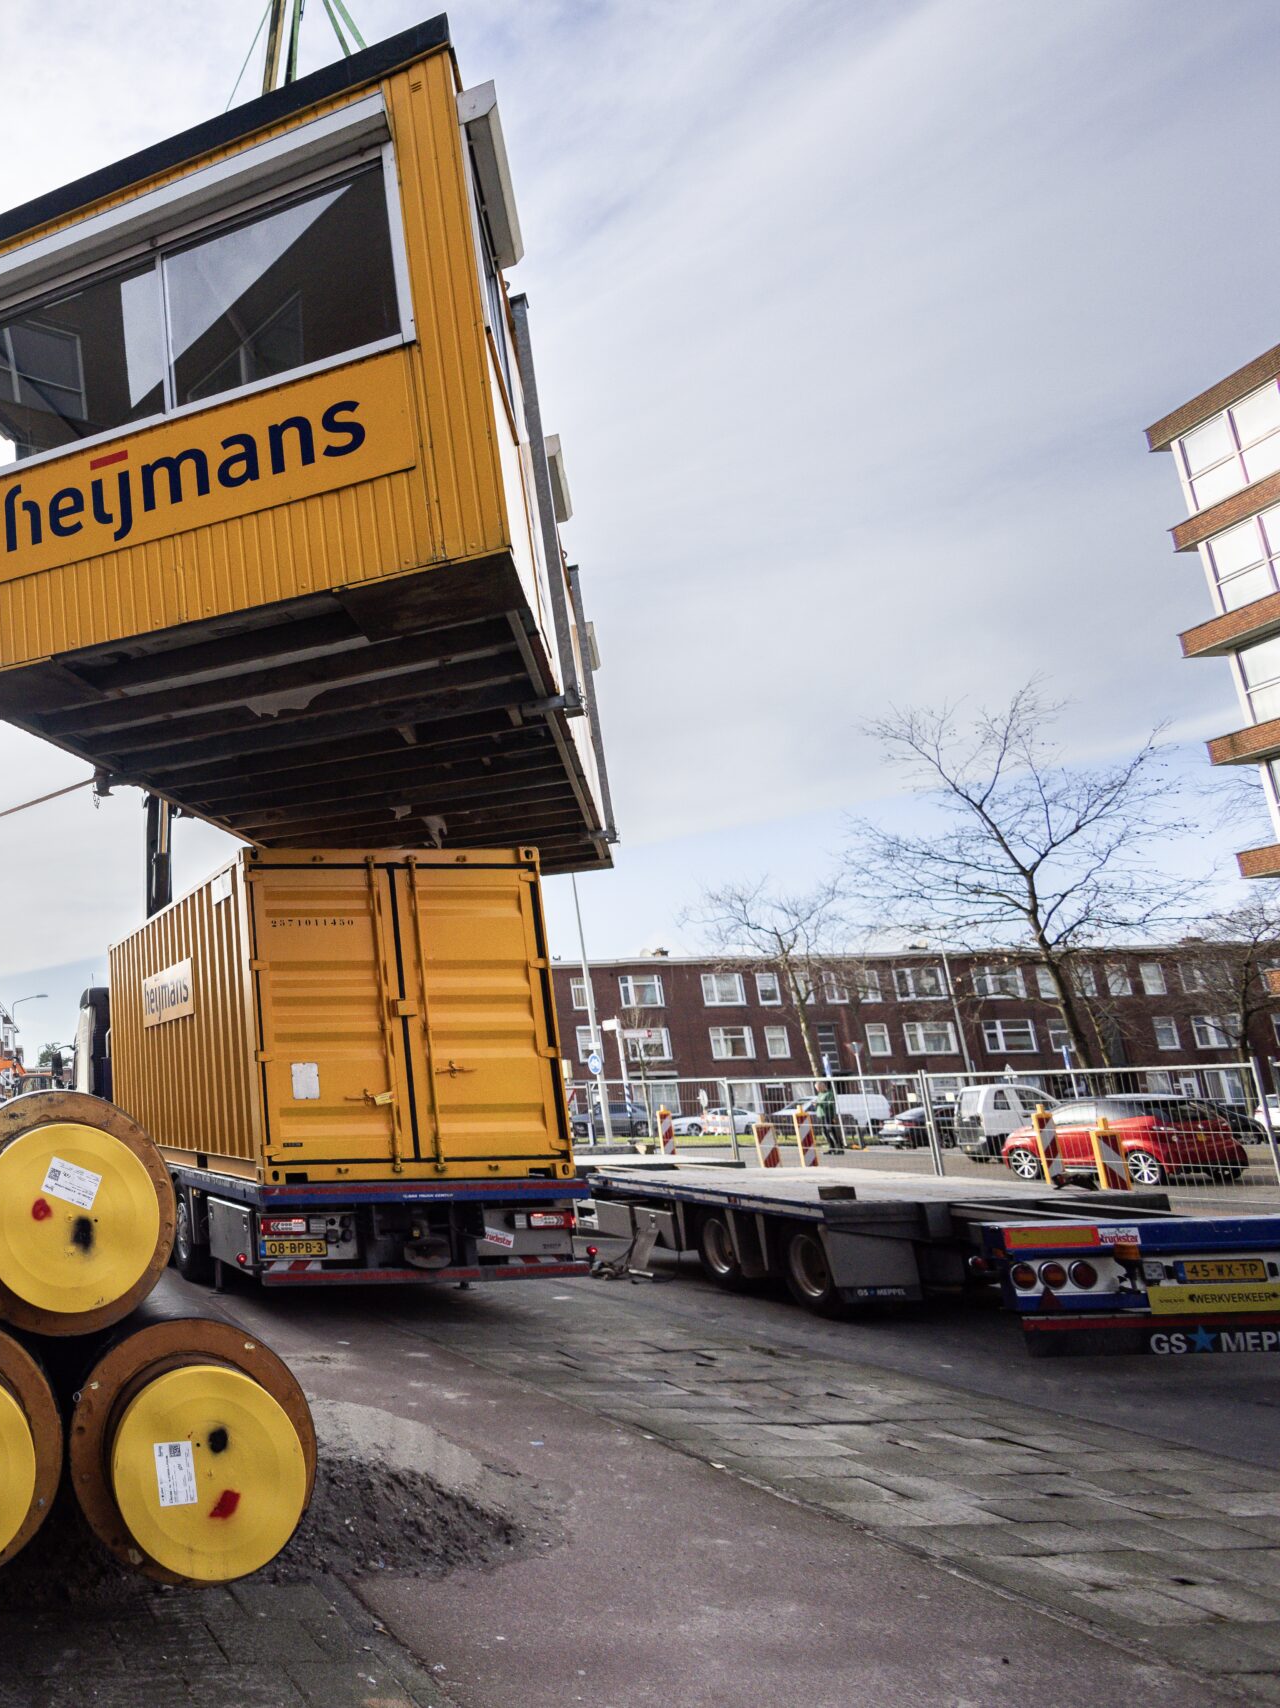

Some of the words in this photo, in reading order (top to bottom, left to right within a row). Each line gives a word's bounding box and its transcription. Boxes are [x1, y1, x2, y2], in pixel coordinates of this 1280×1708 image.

[5, 400, 366, 553] heijmans
[144, 976, 189, 1022] heijmans
[270, 1243, 323, 1254] 08-BPB-3
[1189, 1263, 1258, 1277] 45-WX-TP
[1194, 1292, 1273, 1304] WERKVERKEER
[1150, 1333, 1187, 1354] GS
